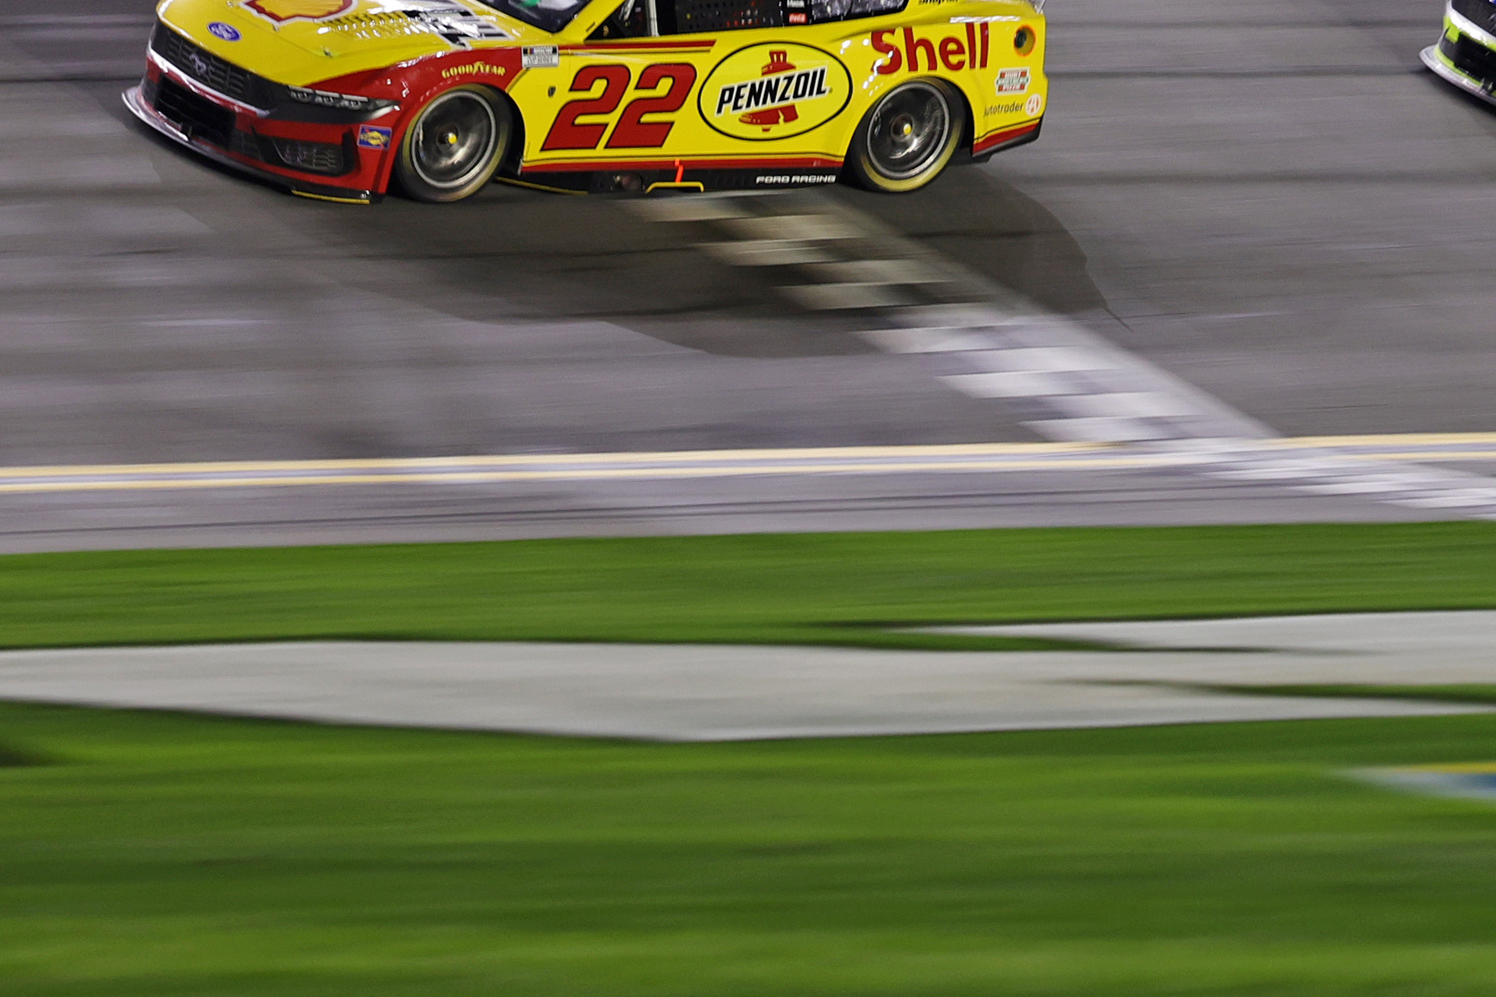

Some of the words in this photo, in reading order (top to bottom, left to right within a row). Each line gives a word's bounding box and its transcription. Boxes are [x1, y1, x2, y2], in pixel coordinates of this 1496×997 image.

[441, 60, 507, 79] GOODYEAR
[870, 20, 990, 76] Shell
[540, 62, 698, 152] 22
[715, 67, 829, 118] PENNZOIL
[756, 175, 790, 184] FORD
[791, 174, 836, 184] RACING
